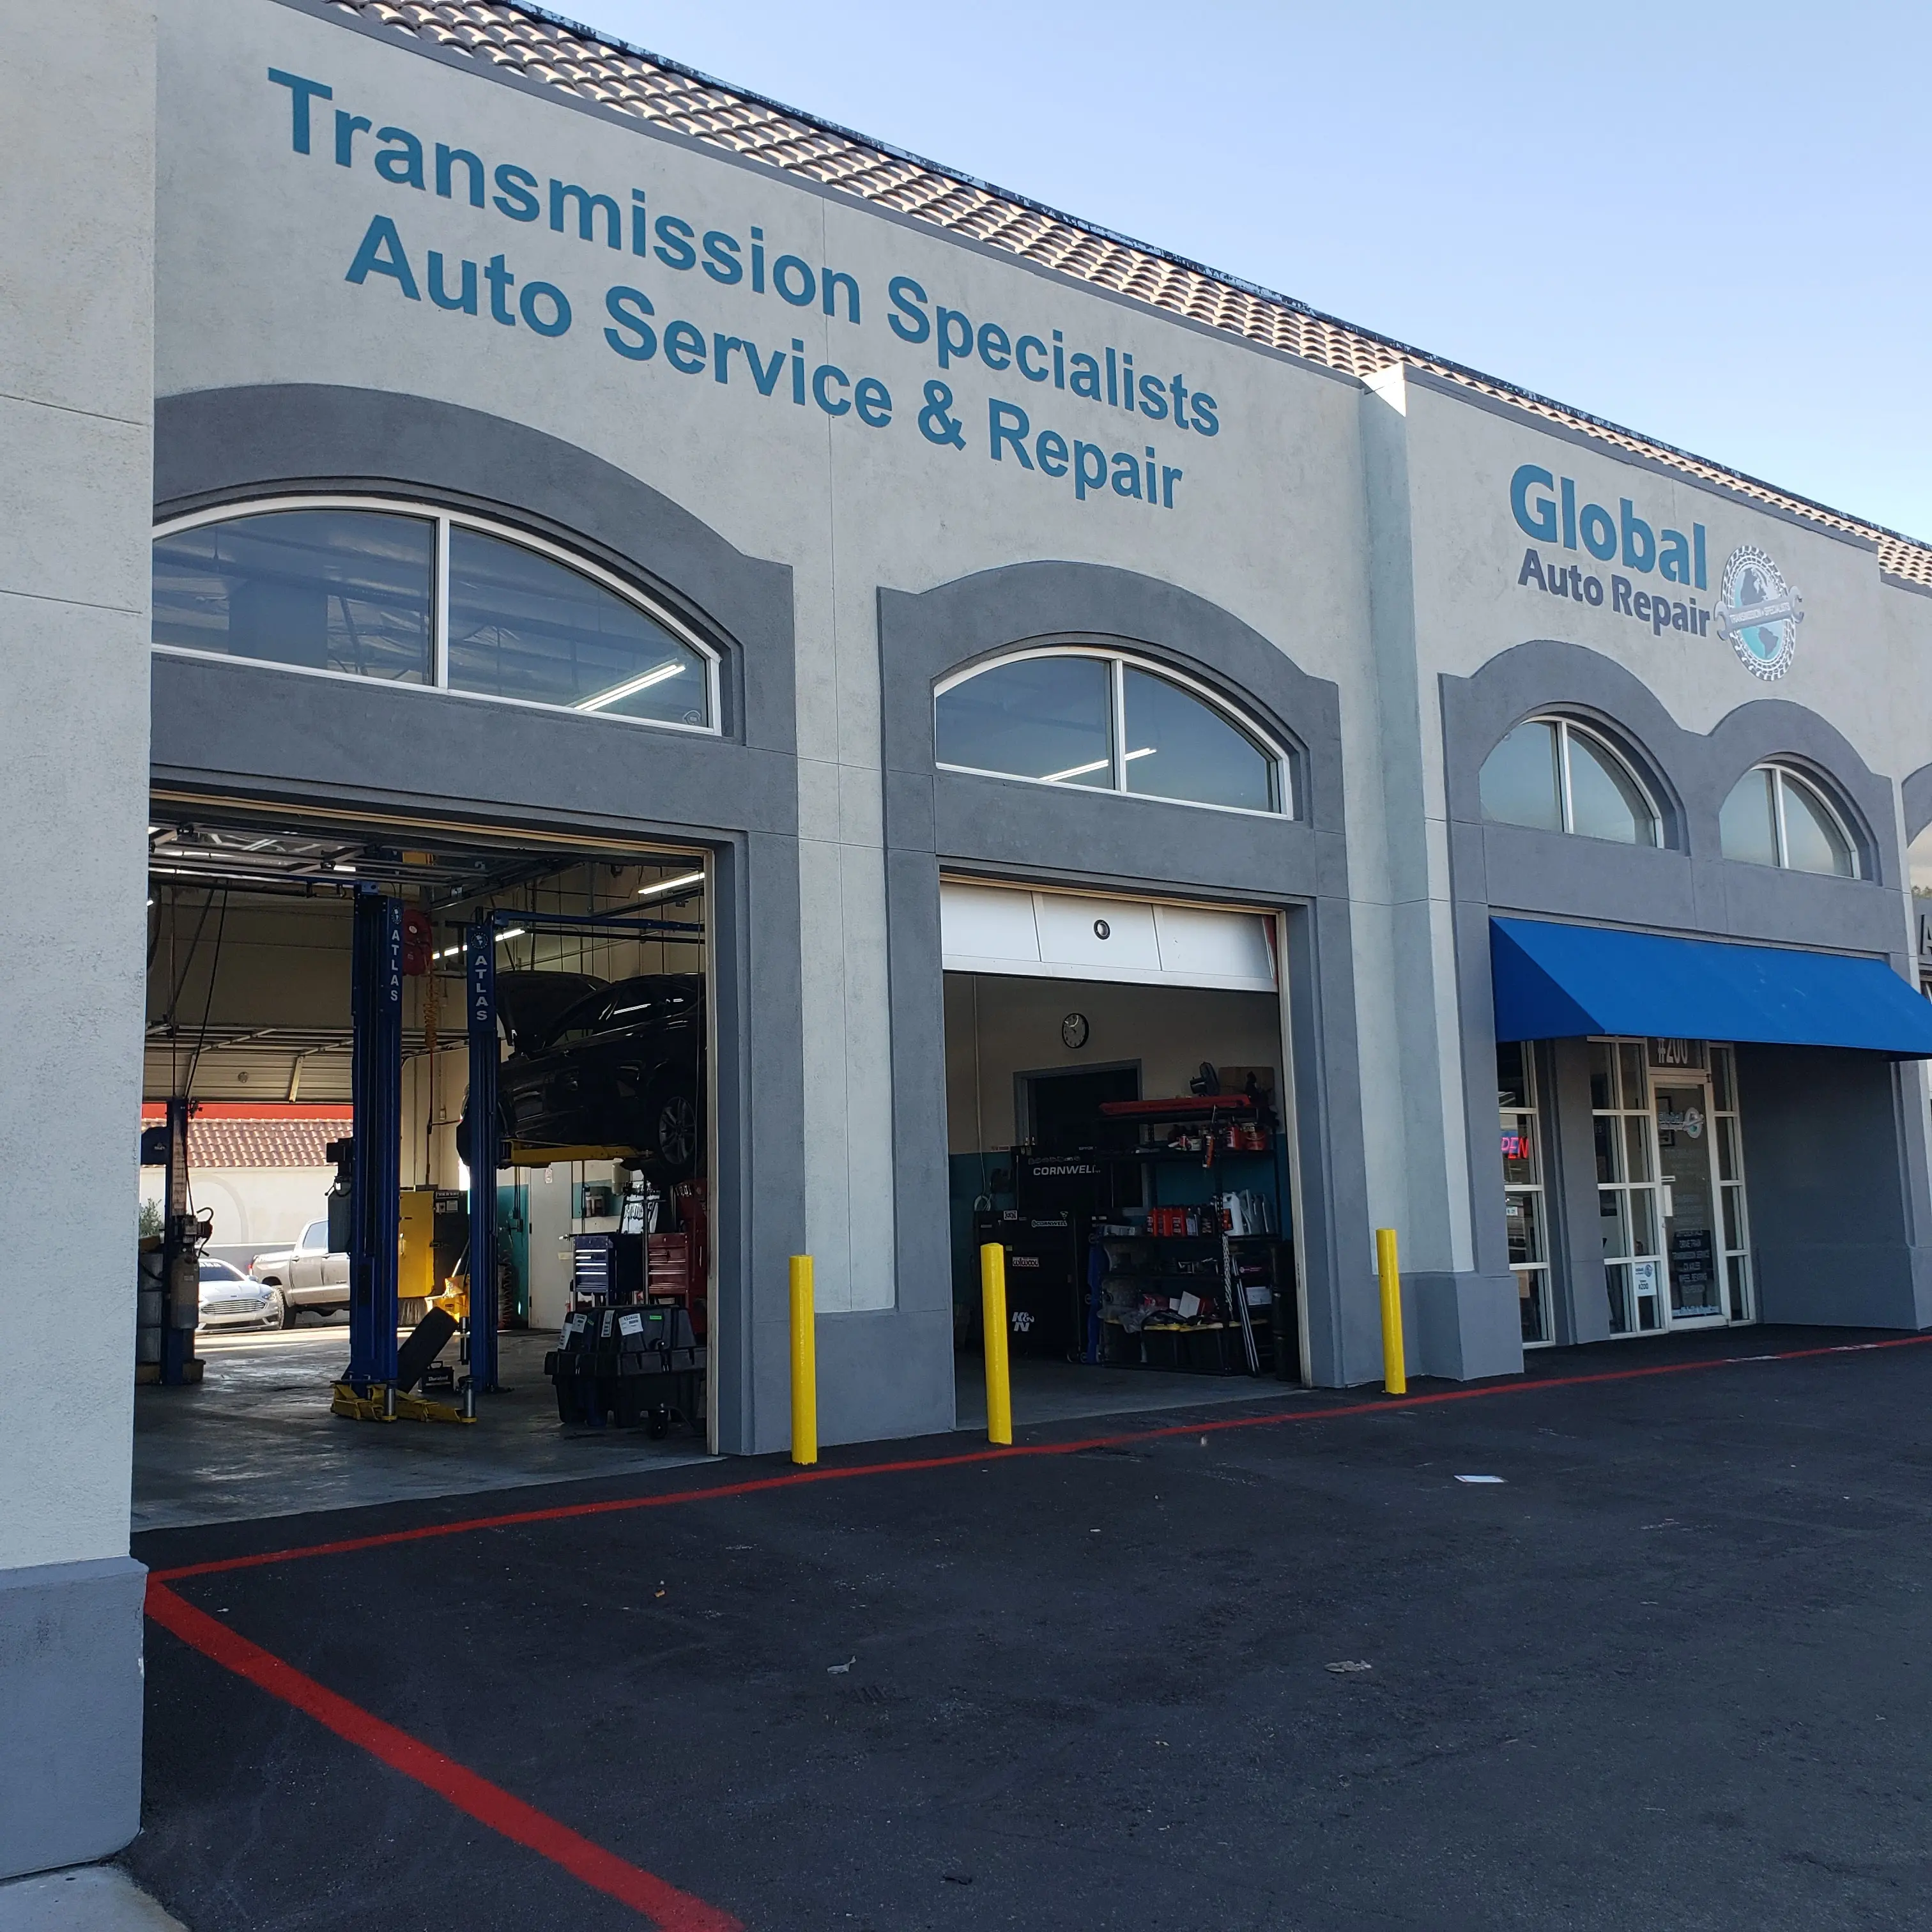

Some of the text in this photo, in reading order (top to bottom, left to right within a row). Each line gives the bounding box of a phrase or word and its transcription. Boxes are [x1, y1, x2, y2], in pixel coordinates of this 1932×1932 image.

[268, 67, 1219, 437] Transmission Specialists
[345, 214, 1183, 509] Auto Service & Repair
[1510, 464, 1707, 590] Global
[1518, 548, 1710, 636] Auto Repair
[390, 929, 401, 1002] ATLAS
[475, 955, 489, 1021] ATLAS
[1501, 1137, 1529, 1160] PEN
